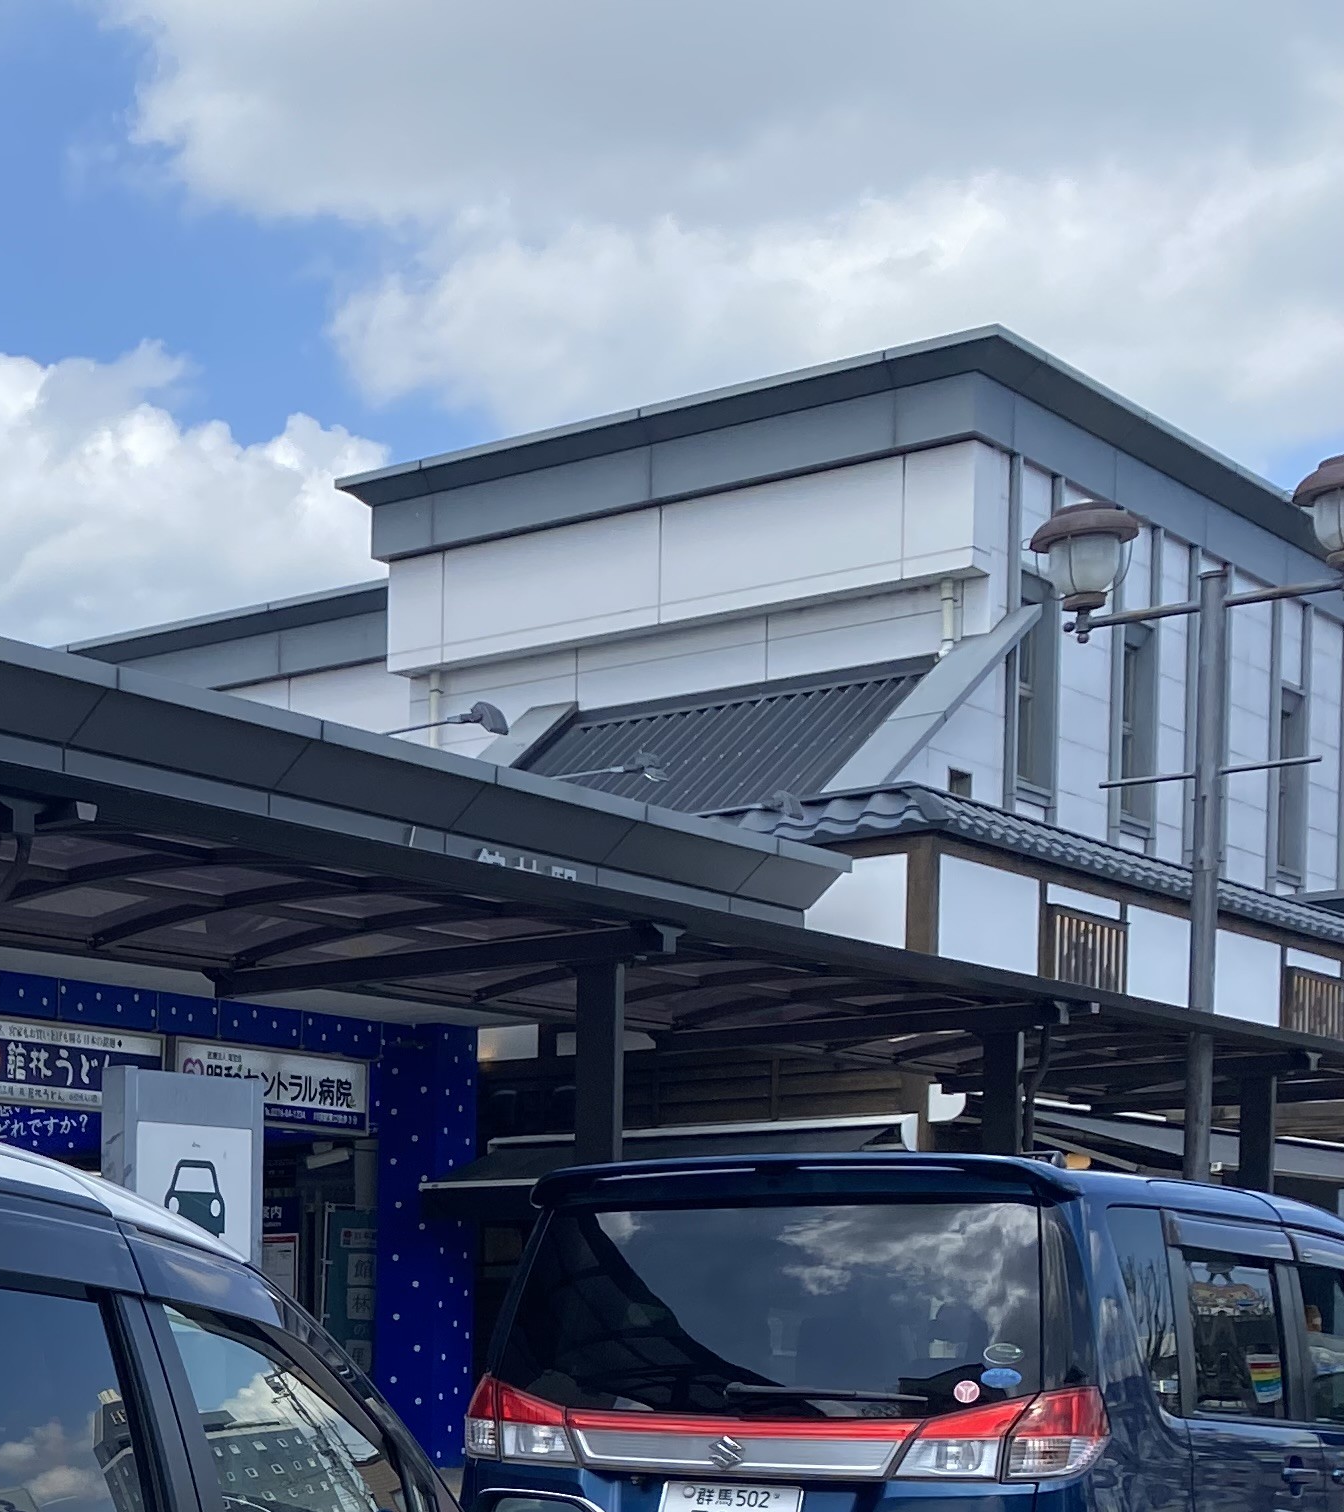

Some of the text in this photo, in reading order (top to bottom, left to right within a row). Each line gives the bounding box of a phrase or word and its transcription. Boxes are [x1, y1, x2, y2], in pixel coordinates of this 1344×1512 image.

[6, 1041, 110, 1086] 館林うど
[696, 1487, 771, 1509] 群馬502
